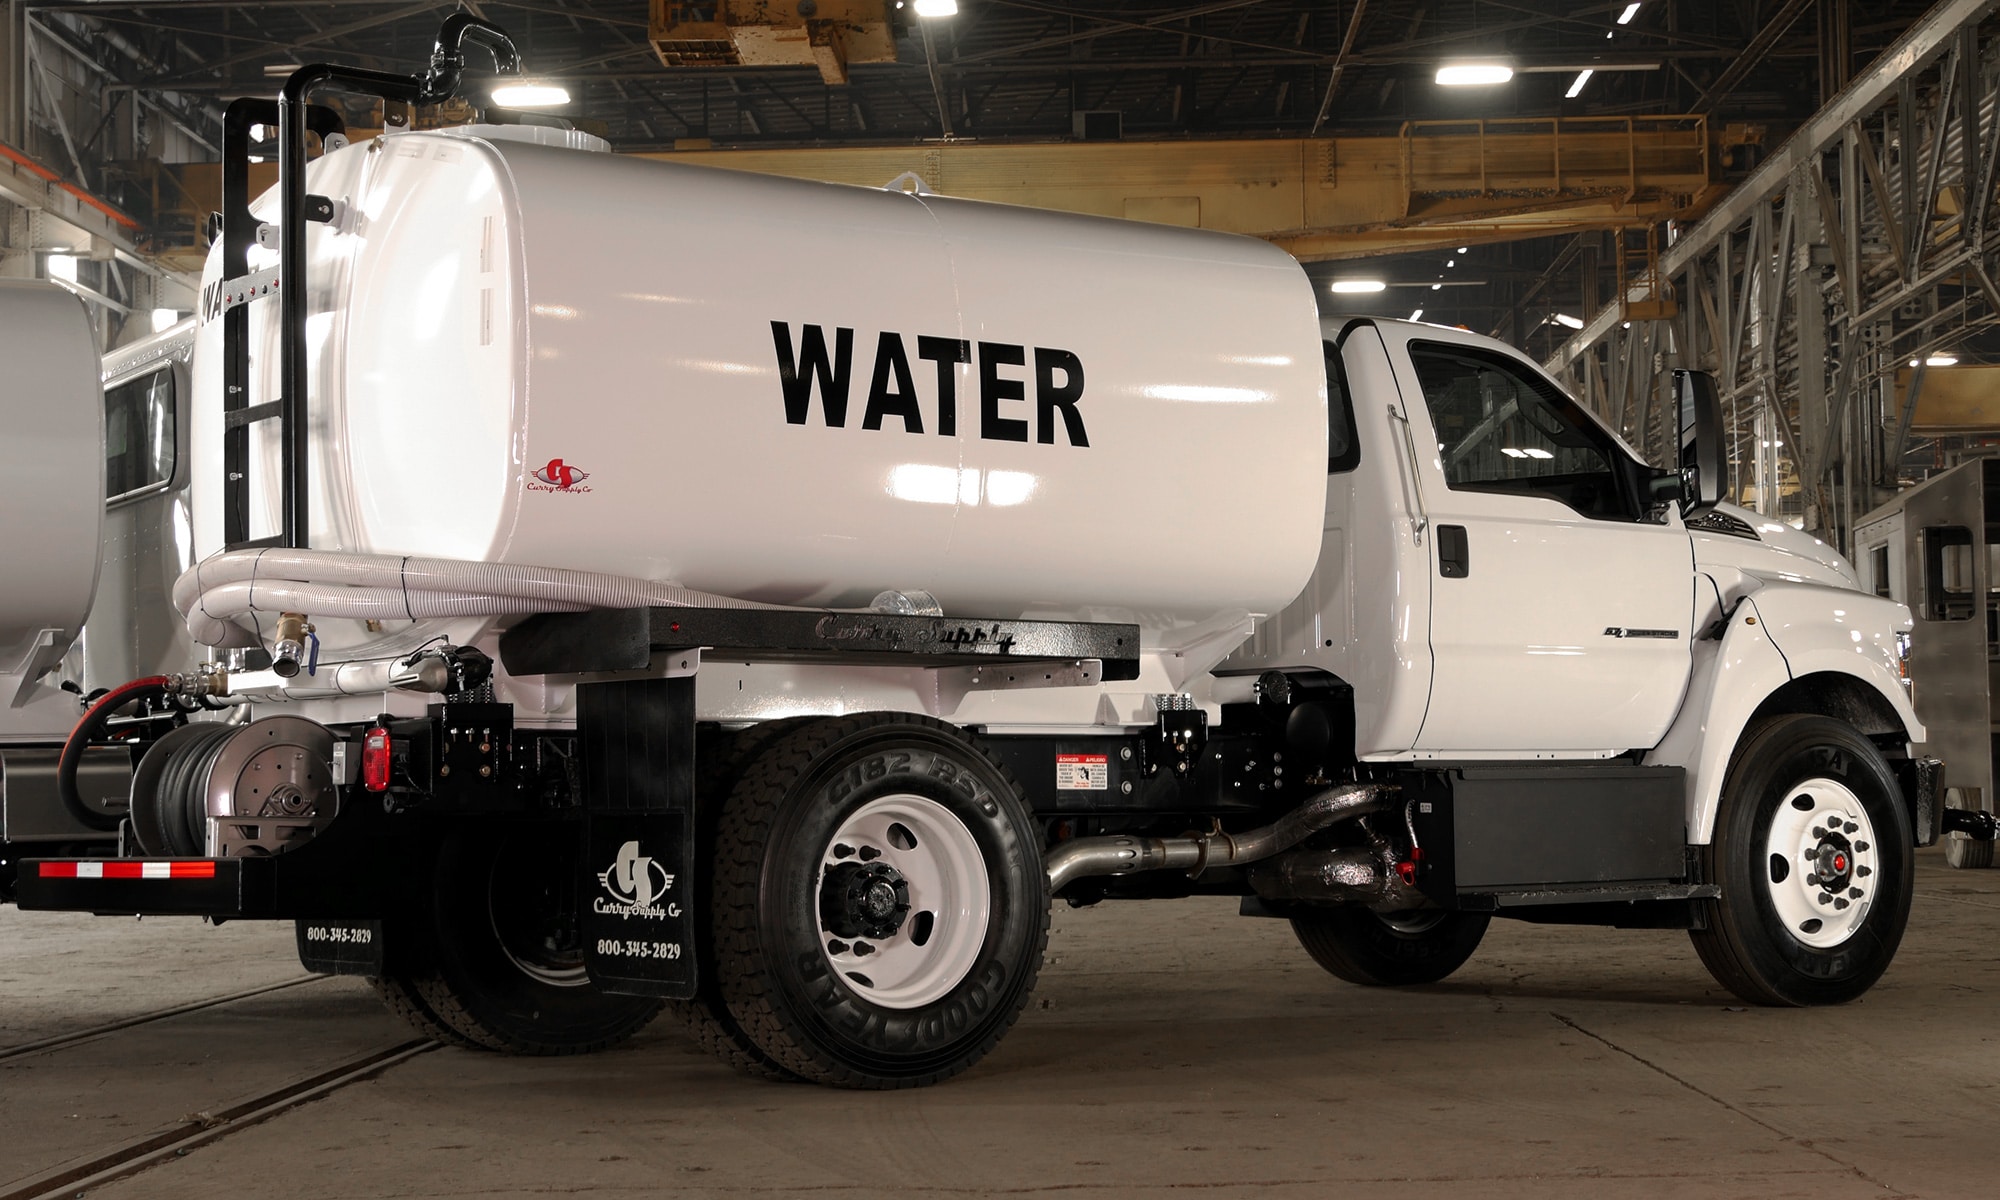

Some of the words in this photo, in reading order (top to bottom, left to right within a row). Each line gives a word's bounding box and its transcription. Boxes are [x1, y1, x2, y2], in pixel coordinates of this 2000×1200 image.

[770, 320, 1090, 447] WATER
[526, 482, 554, 493] Curry
[815, 614, 902, 650] Curry
[914, 619, 1016, 653] Supply
[826, 752, 911, 806] G182
[927, 754, 999, 819] RSD
[593, 896, 630, 920] Curry
[630, 900, 667, 921] Supply
[307, 926, 372, 943] 800-345-2829
[597, 939, 681, 959] 800-345-2829
